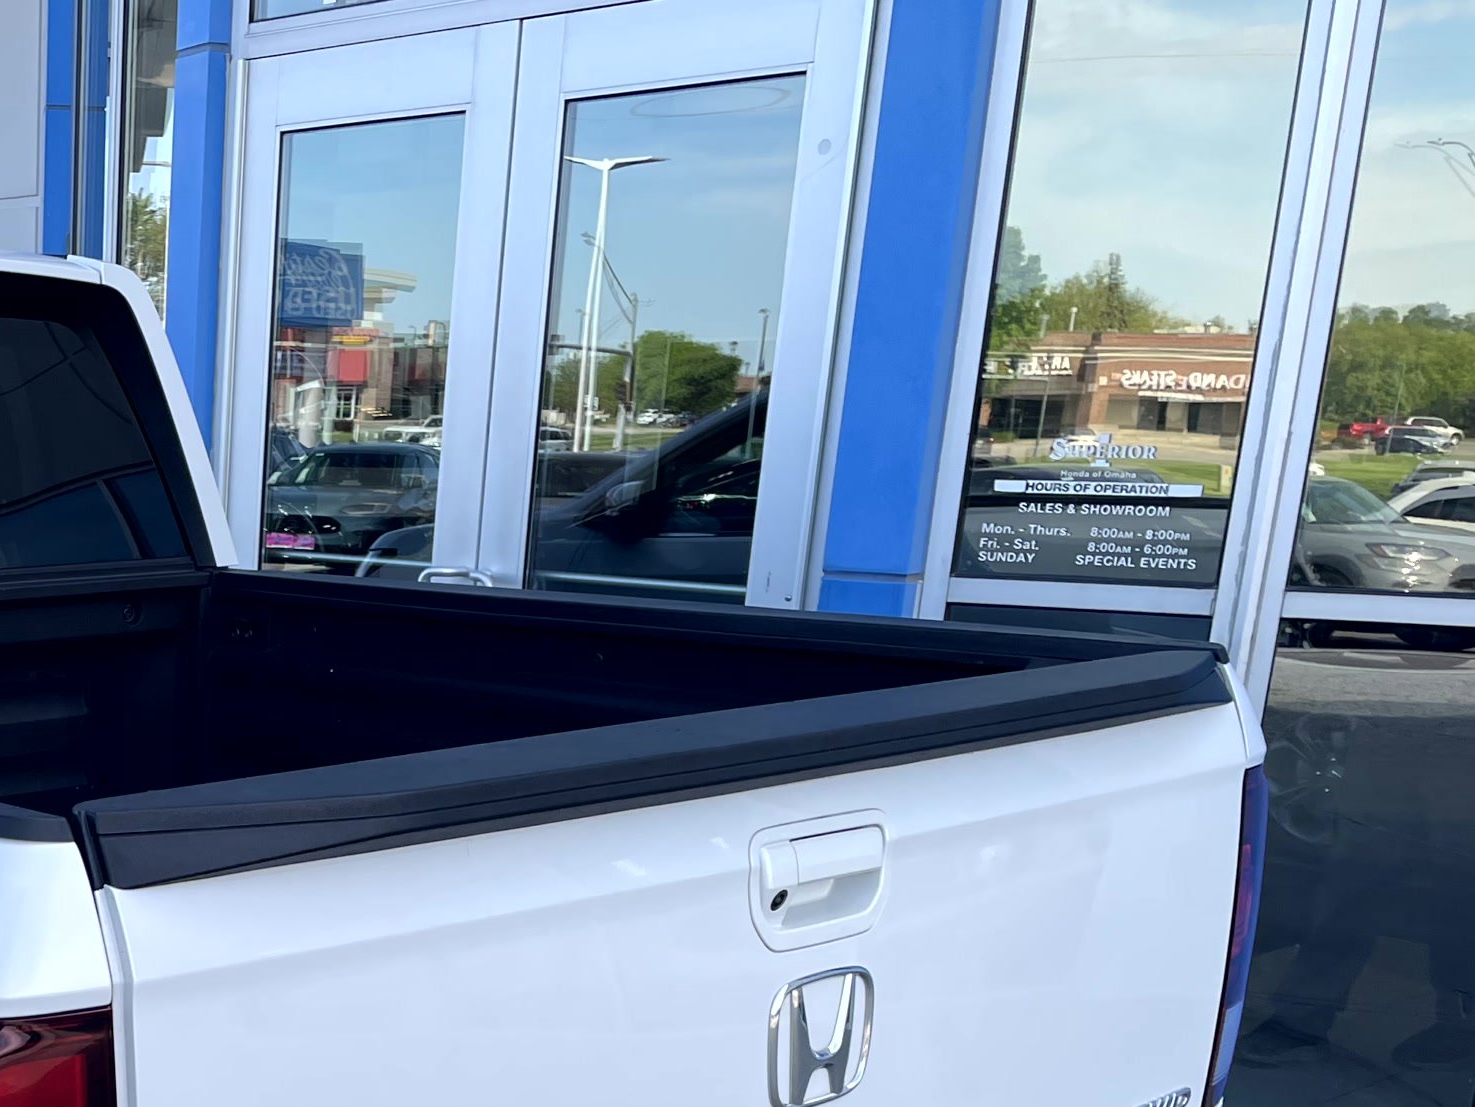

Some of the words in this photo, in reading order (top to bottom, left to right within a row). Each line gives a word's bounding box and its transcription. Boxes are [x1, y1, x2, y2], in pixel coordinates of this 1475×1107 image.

[1060, 470, 1090, 479] Honda
[1092, 470, 1103, 478] of
[1104, 470, 1137, 479] Omaha
[1025, 482, 1071, 493] HOURS
[1073, 483, 1092, 493] OF
[1093, 484, 1170, 496] OPERATION
[1018, 502, 1063, 515] SALES
[1067, 504, 1076, 515] &
[1080, 504, 1171, 517] SHOWROOM
[981, 523, 1016, 535] Mon.
[1028, 524, 1072, 537] Thurs.
[979, 538, 1001, 549] Fri.
[1013, 539, 1040, 551] Sat.
[977, 551, 1036, 563] SUNDAY
[1075, 555, 1135, 568] SPECIAL
[1139, 557, 1197, 570] EVENTS
